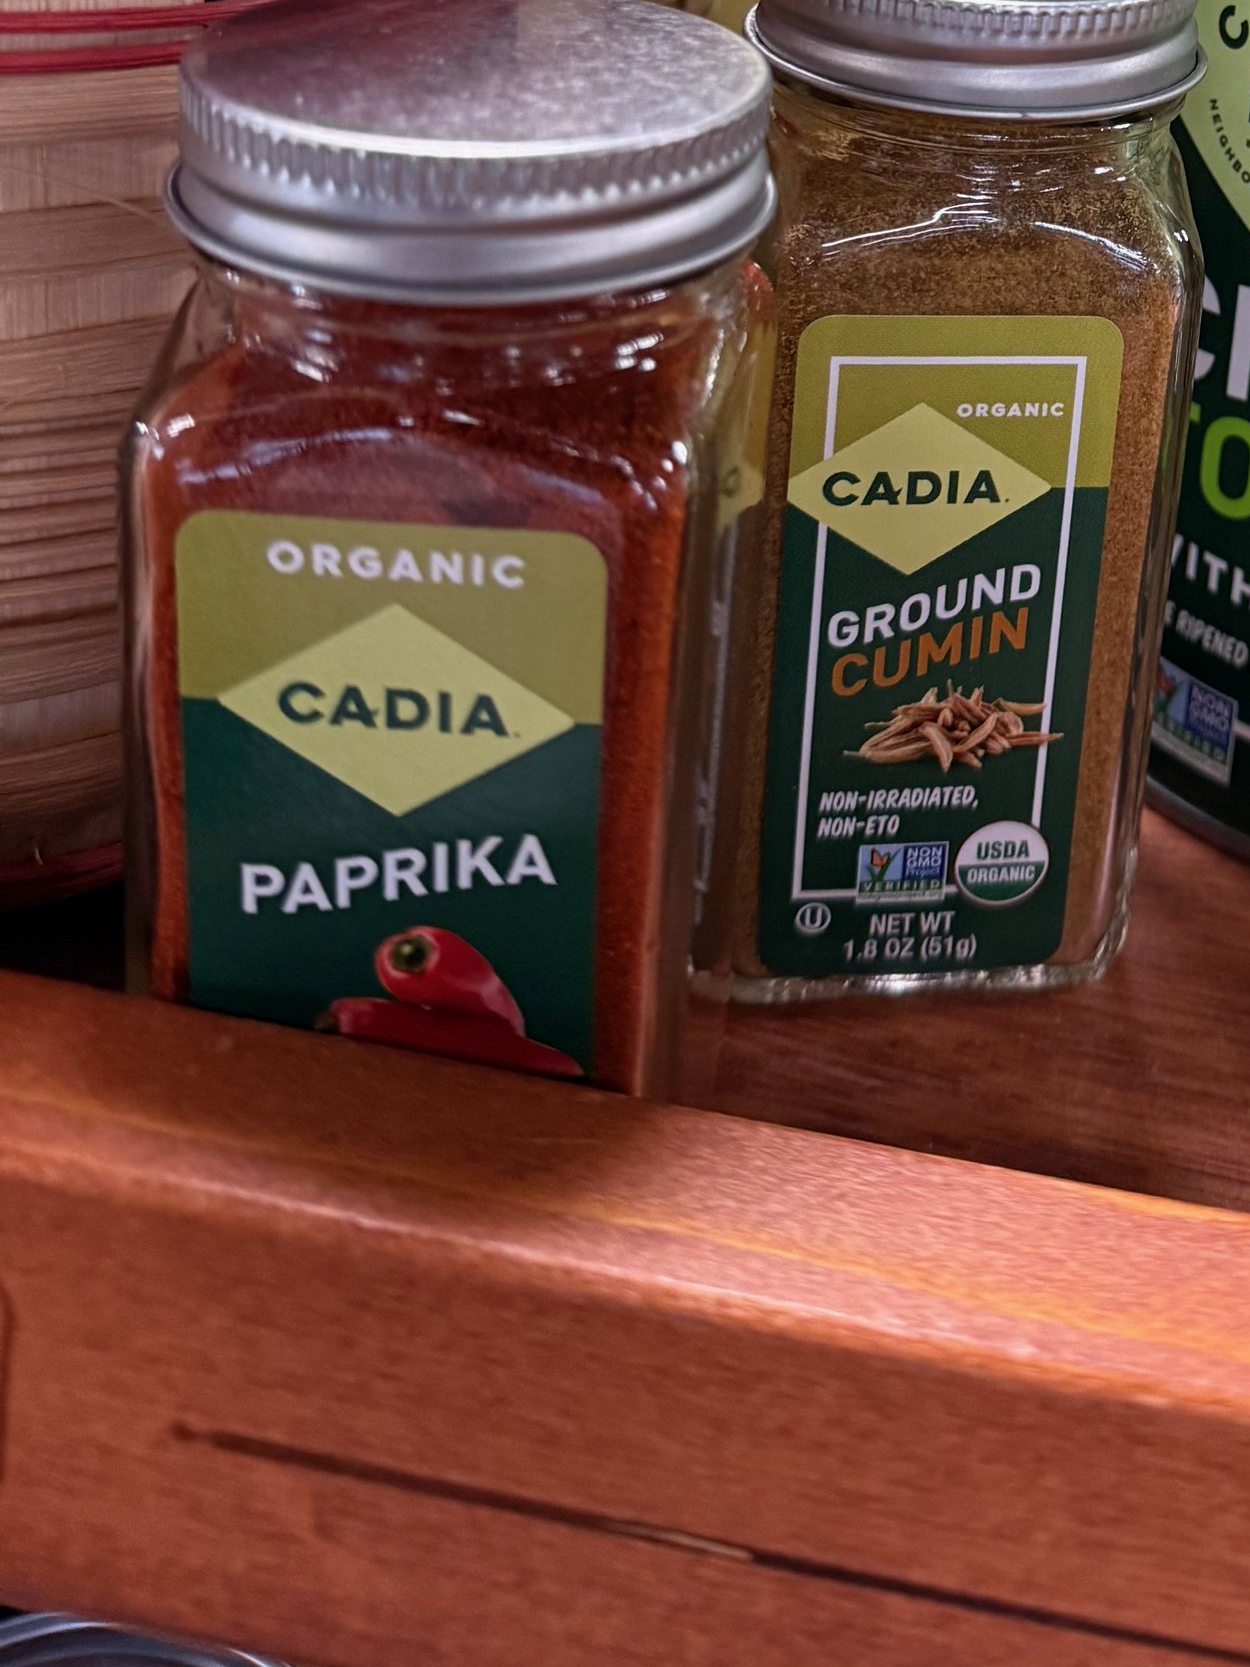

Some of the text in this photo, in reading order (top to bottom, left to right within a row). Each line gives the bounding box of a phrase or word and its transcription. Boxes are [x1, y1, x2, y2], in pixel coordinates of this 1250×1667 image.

[956, 402, 1065, 419] ORGANIC
[822, 469, 1003, 507] CADIA
[266, 540, 527, 589] ORGANIC
[828, 562, 1042, 649] GROUND
[831, 607, 1029, 697] CUMIN
[1175, 609, 1249, 668] RIPENED
[277, 681, 512, 739] CADIA
[819, 786, 979, 813] NON-IRRADIATED,
[817, 814, 901, 838] NON-ETO
[906, 856, 942, 868] GMO
[907, 846, 943, 858] NON
[976, 840, 1030, 861] USDA
[240, 833, 558, 915] PAPRIKA
[863, 879, 941, 892] VERIFIED
[967, 864, 1036, 884] ORGANIC
[869, 910, 957, 935] NET WT
[843, 934, 977, 961] 1.8 OZ (51g)
